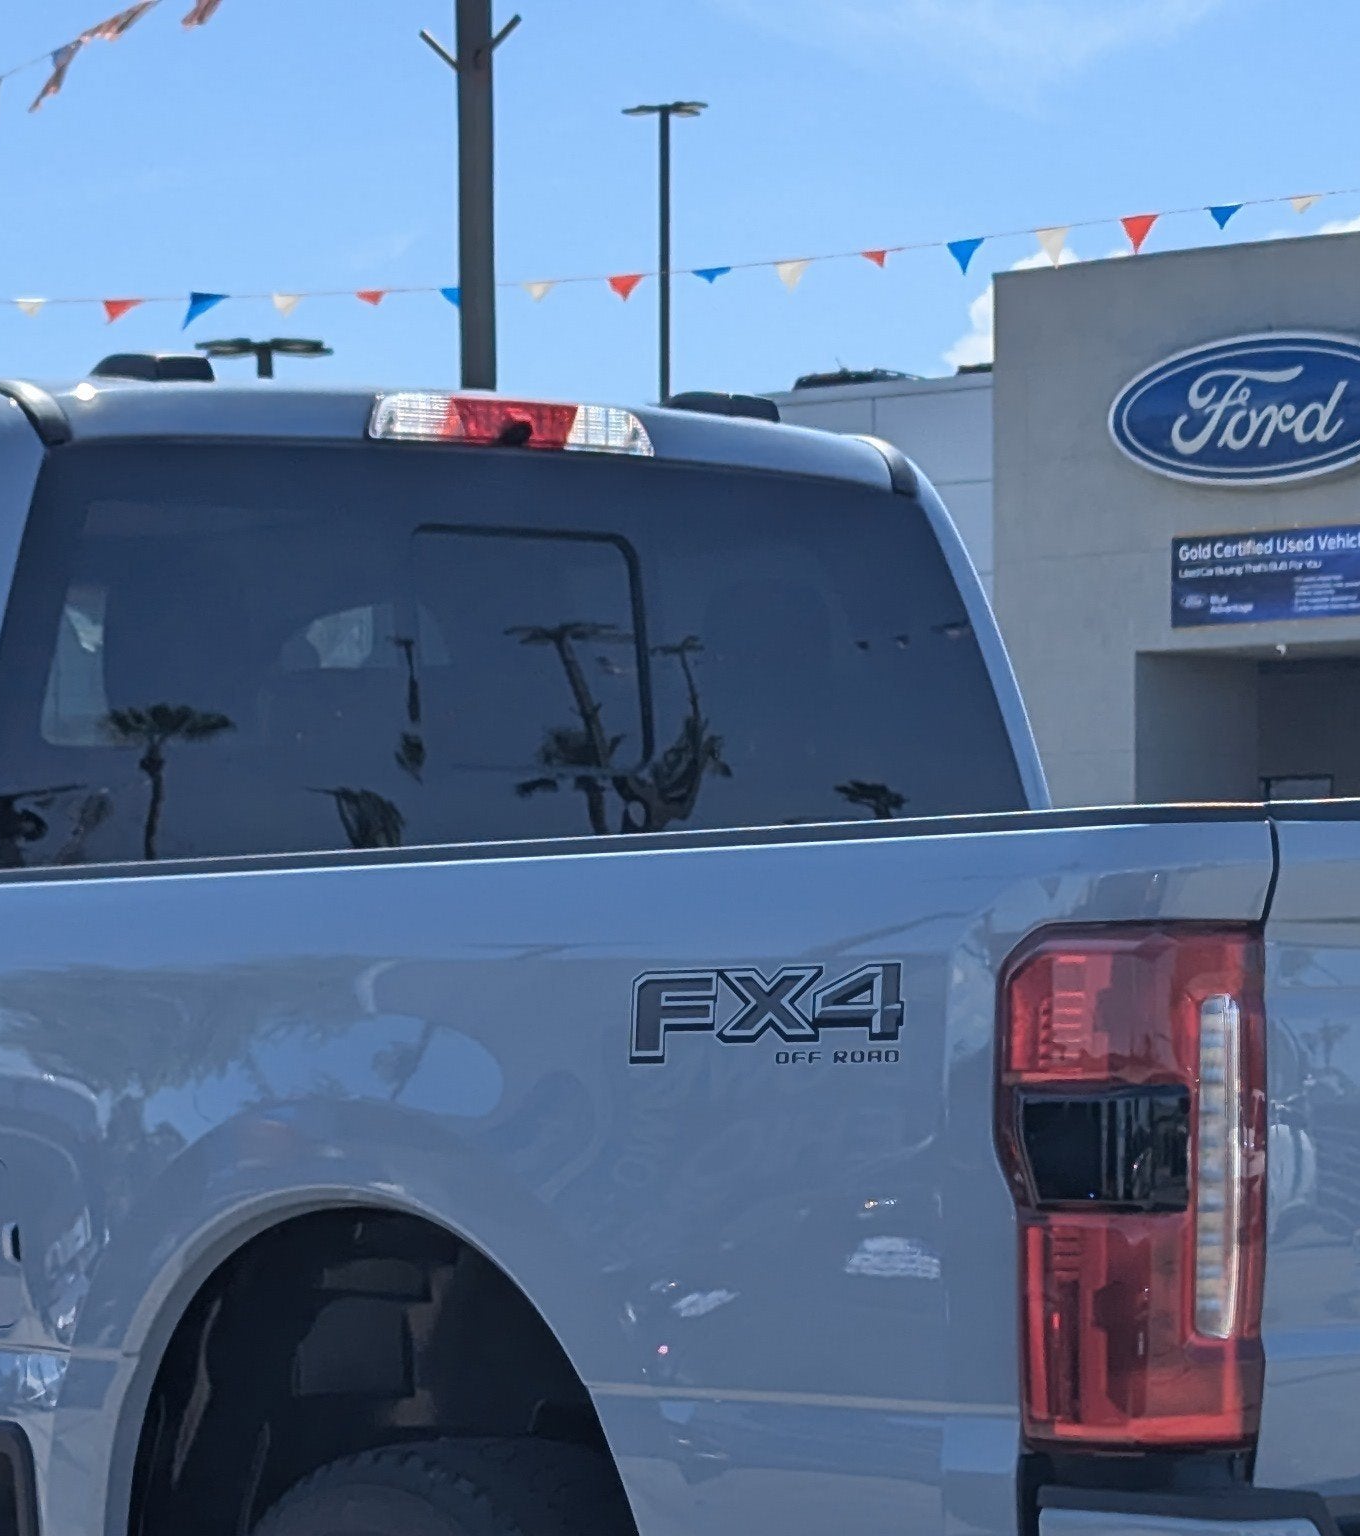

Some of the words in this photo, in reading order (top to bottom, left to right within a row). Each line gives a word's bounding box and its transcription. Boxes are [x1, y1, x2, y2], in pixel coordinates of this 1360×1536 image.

[1171, 364, 1347, 455] Ford
[1178, 542, 1211, 561] Gold
[1213, 537, 1274, 559] Certified
[1276, 535, 1315, 554] Used
[628, 961, 905, 1065] FX4
[775, 1050, 822, 1064] OFF
[833, 1049, 900, 1063] ROAD
